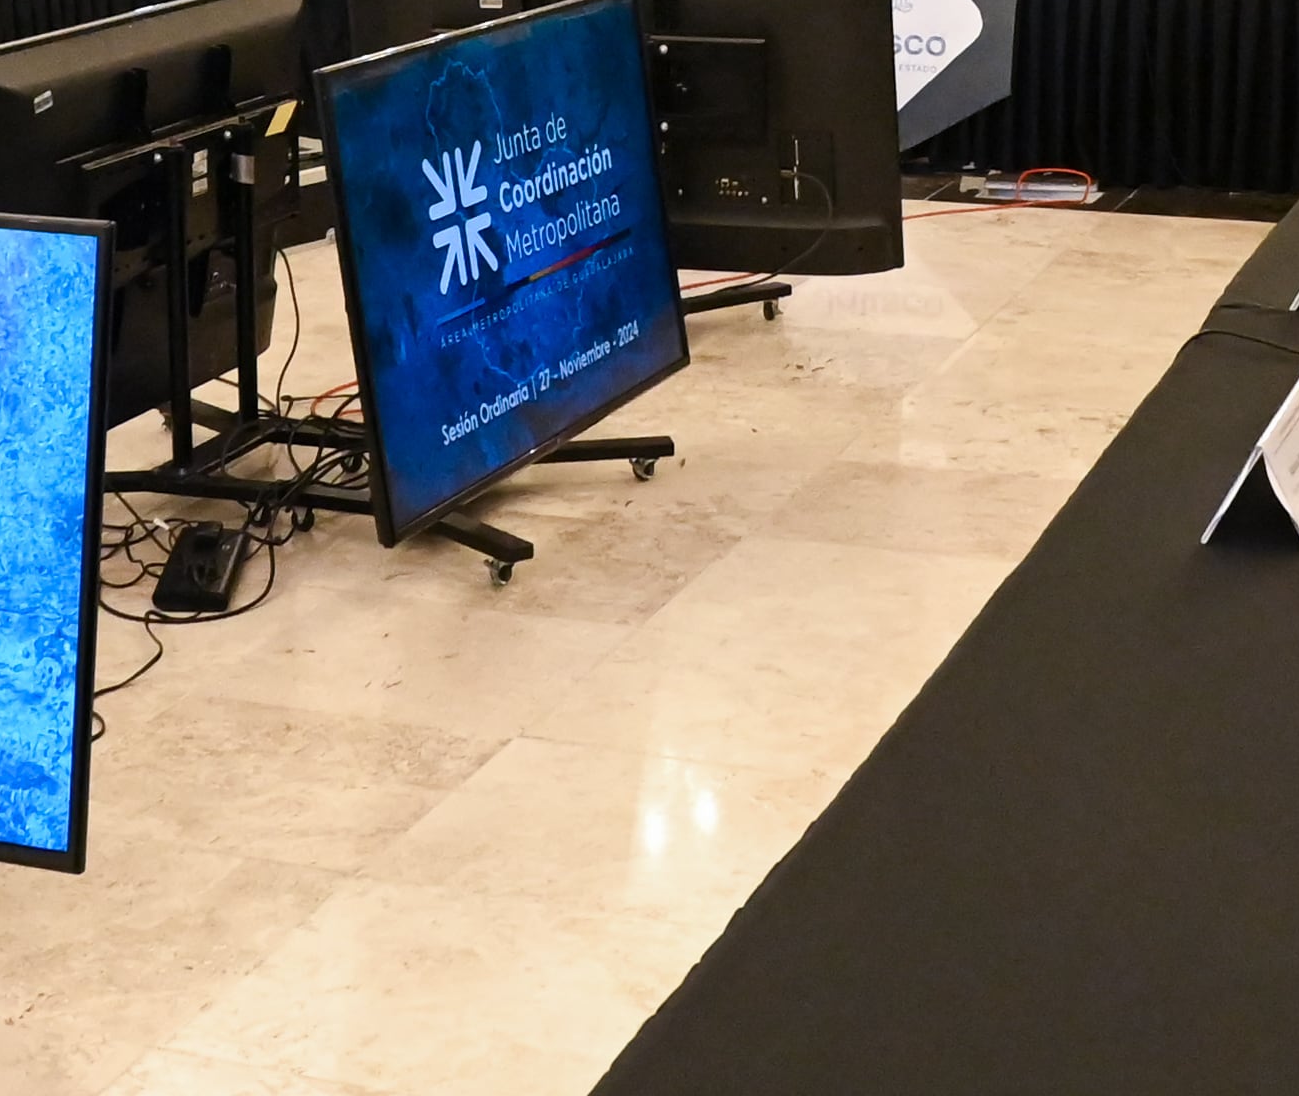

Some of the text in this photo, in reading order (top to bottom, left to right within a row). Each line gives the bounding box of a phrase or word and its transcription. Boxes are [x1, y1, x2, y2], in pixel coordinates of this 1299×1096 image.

[898, 63, 937, 74] ESTADO
[493, 112, 567, 164] Junta de
[499, 143, 613, 213] Coordinación
[505, 194, 621, 264] Metropolitana
[472, 286, 554, 331] METROPOLITANA
[556, 280, 570, 292] DE
[572, 247, 635, 283] GUADALAJARA
[441, 411, 479, 446] Sesión
[479, 383, 530, 424] Ordinaria
[539, 368, 550, 392] 27
[559, 340, 611, 381] Noviembre
[617, 320, 640, 348] 2024
